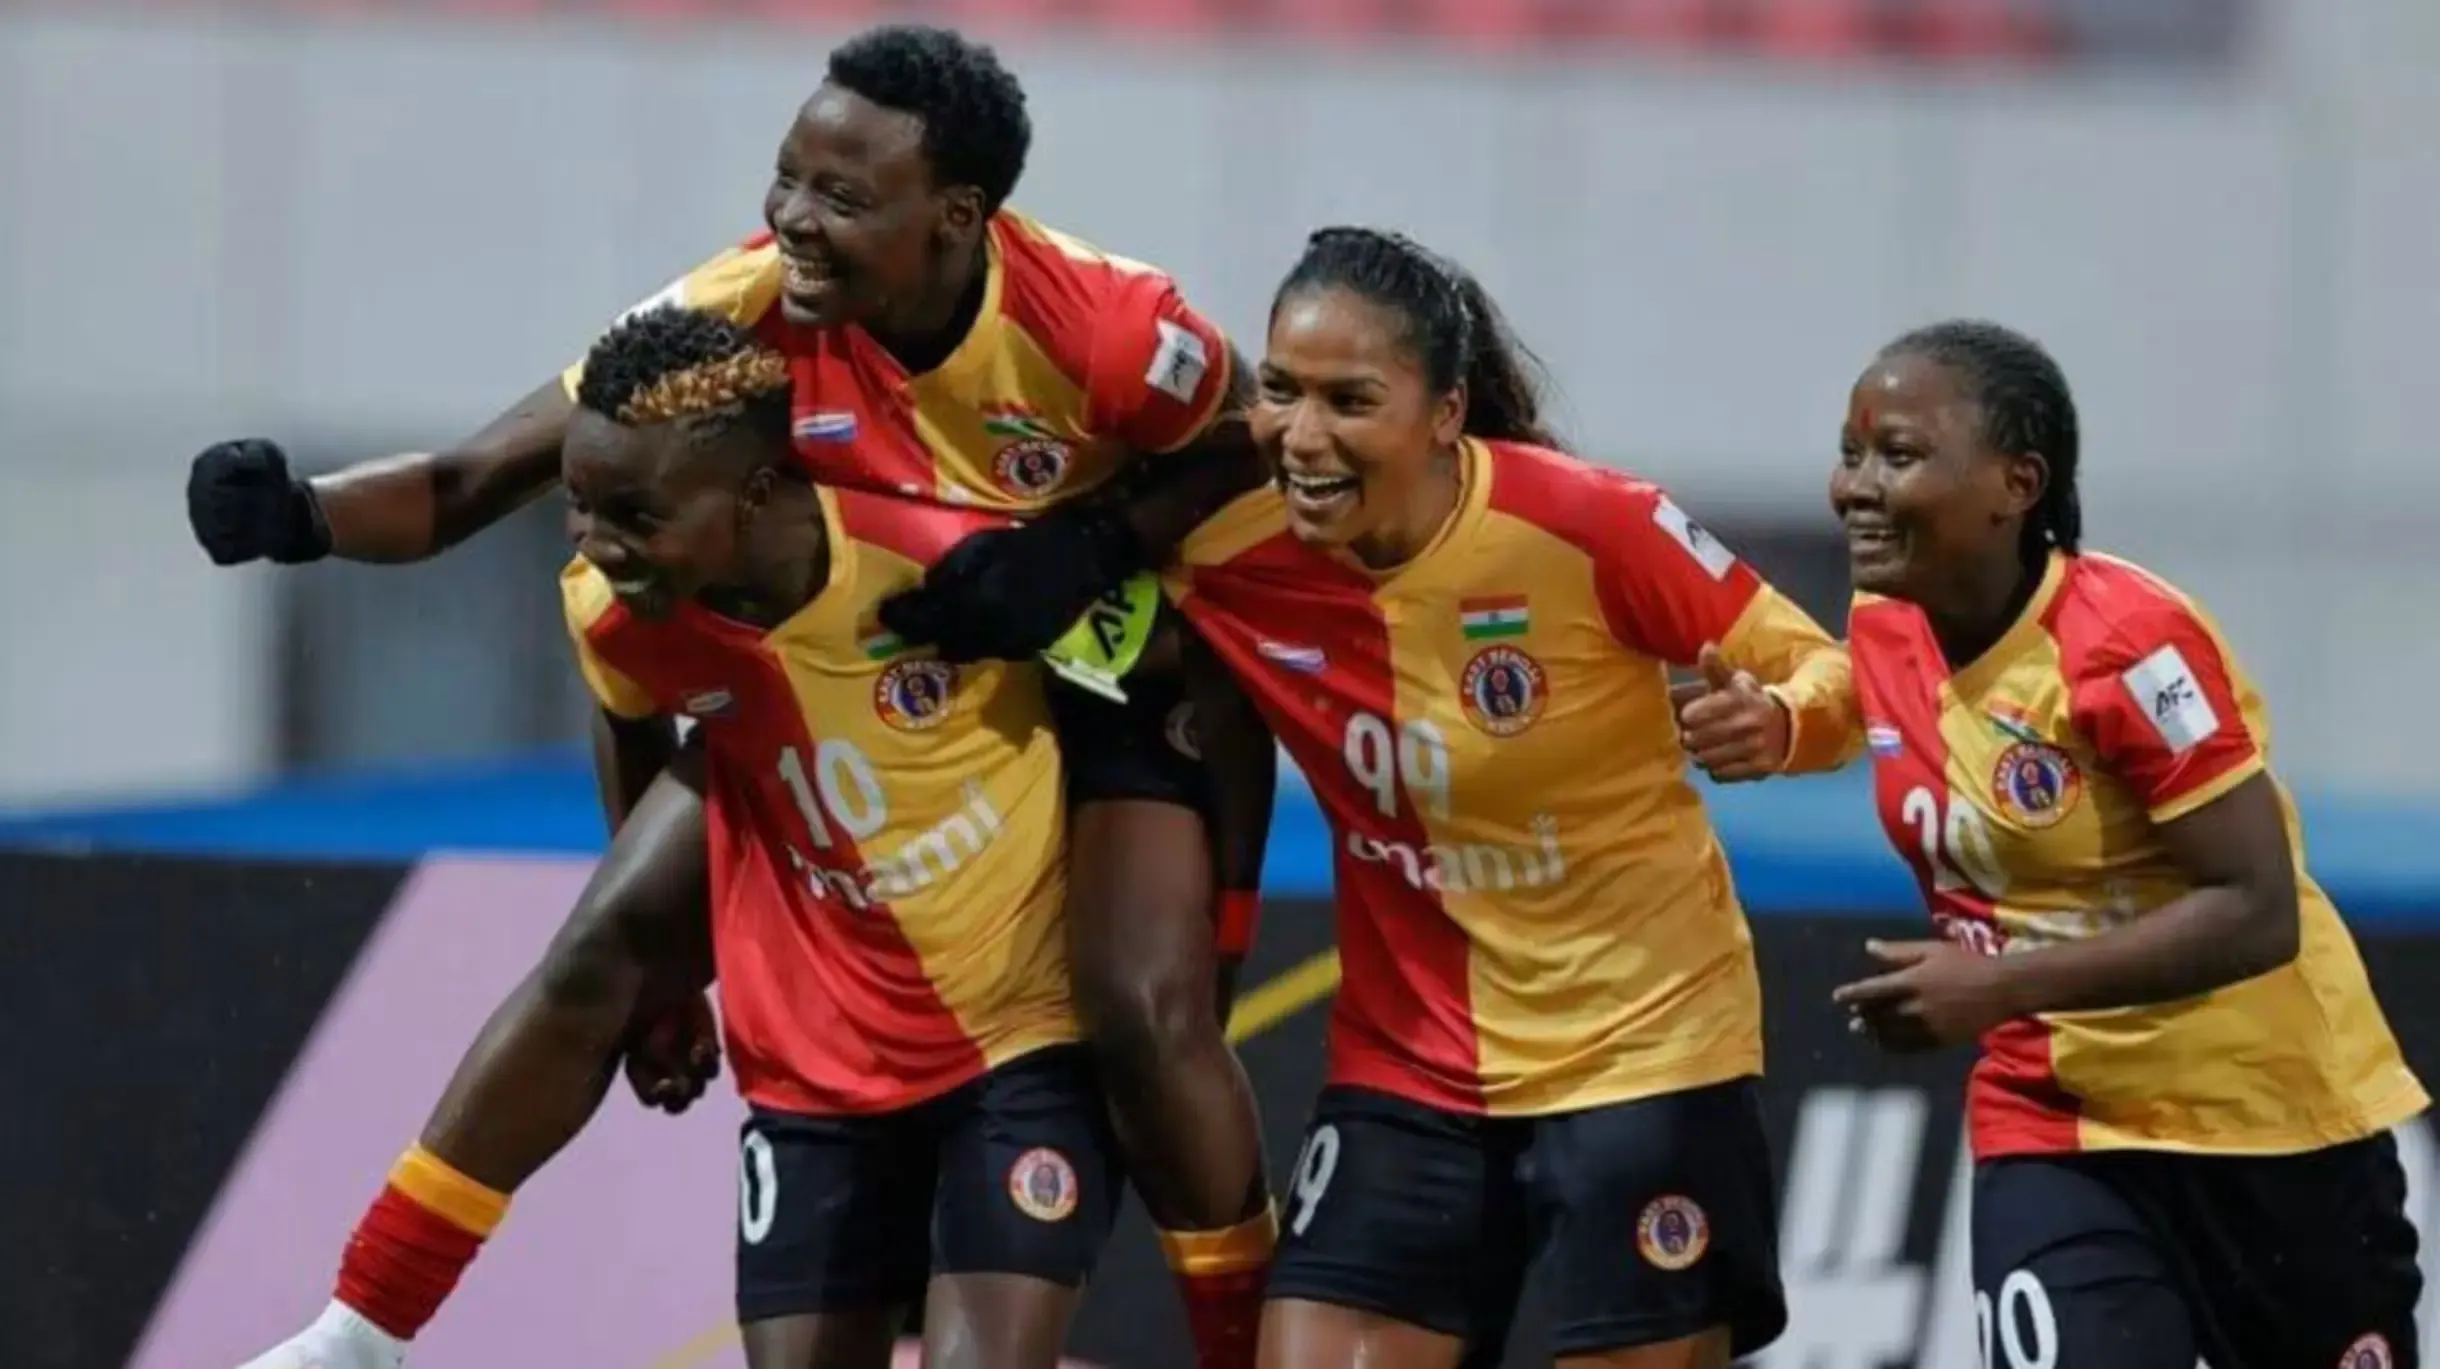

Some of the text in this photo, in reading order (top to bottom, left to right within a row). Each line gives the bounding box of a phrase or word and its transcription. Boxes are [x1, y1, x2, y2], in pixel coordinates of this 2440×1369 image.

[777, 737, 889, 849] 10
[1344, 710, 1450, 820] 99
[1902, 785, 2008, 897] 20
[1287, 1123, 1340, 1236] 9
